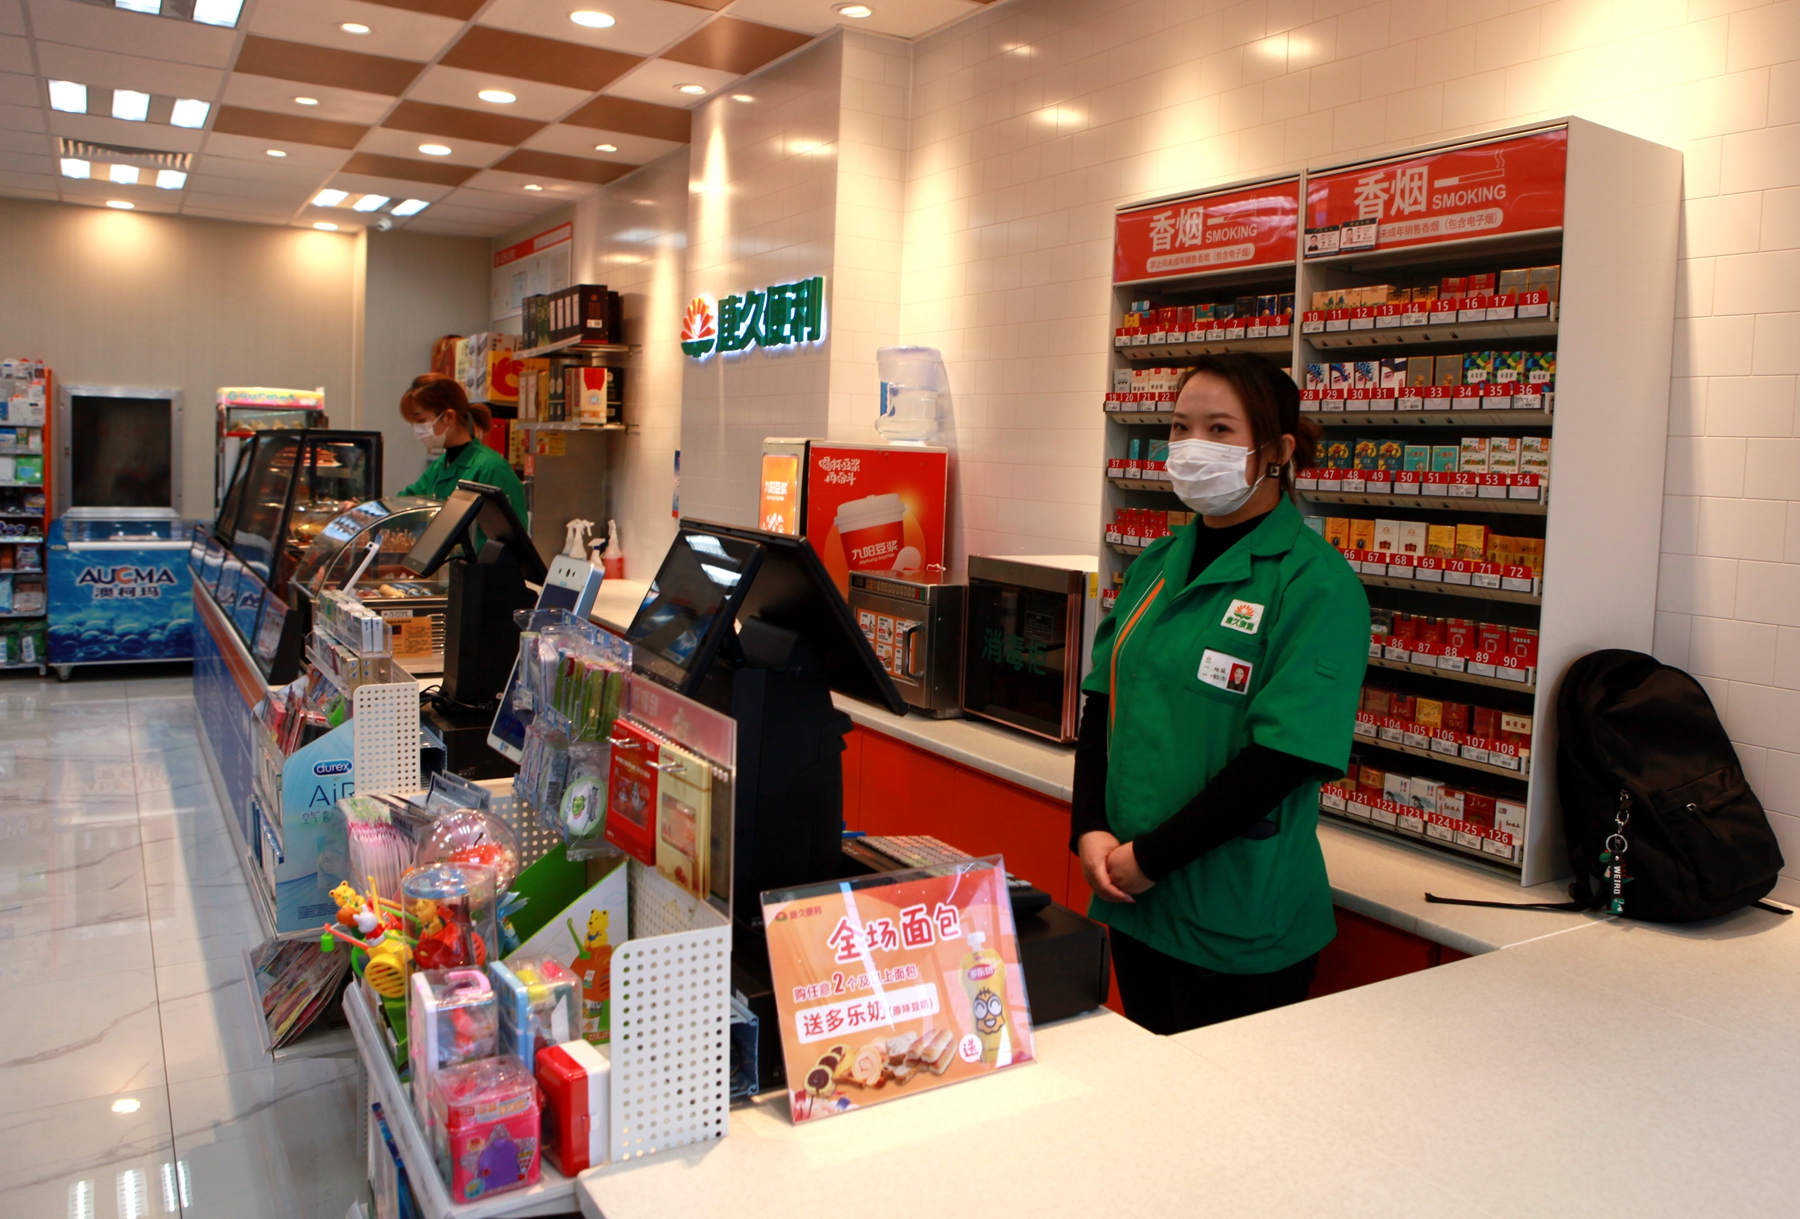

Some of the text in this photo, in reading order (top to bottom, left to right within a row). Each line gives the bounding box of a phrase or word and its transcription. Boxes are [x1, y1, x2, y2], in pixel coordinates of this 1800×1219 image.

[1354, 165, 1429, 221] 香烟
[1432, 184, 1507, 210] SMOKING
[1149, 206, 1204, 252] 香烟
[1377, 212, 1498, 239] 未成年销售香烟（包含电子烟）
[1205, 223, 1257, 244] SMOKING
[1465, 298, 1478, 309] 16
[1494, 296, 1507, 307] 17
[1525, 293, 1540, 304] 18
[1382, 305, 1394, 315] 13
[1407, 303, 1419, 314] 14
[1436, 301, 1449, 312] 15
[716, 277, 823, 352] 唐久便利
[1307, 312, 1318, 322] 10
[1331, 310, 1342, 319] 11
[1356, 308, 1367, 318] 12
[1303, 390, 1314, 400] 28
[1326, 390, 1337, 400] 29
[1352, 389, 1364, 399] 30
[1376, 389, 1387, 398] 31
[1404, 388, 1416, 397] 32
[1430, 387, 1442, 397] 33
[1459, 387, 1472, 397] 34
[1489, 385, 1503, 396] 35
[1519, 384, 1533, 395] 36
[227, 391, 297, 403] Gourmet
[1109, 393, 1117, 401] 19
[1125, 393, 1134, 401] 20
[1142, 393, 1150, 401] 21
[819, 456, 860, 472] 喝杯豆浆
[1146, 462, 1155, 470] 39
[824, 472, 856, 485] 再奋斗
[1323, 469, 1334, 479] 47
[1347, 471, 1358, 480] 48
[1372, 471, 1384, 481] 49
[1401, 472, 1413, 482] 50
[1428, 473, 1440, 483] 51
[1455, 474, 1468, 484] 52
[1485, 474, 1499, 485] 53
[1517, 475, 1531, 485] 54
[1109, 525, 1118, 533] 55
[1127, 527, 1135, 535] 56
[851, 540, 898, 560] 九阳豆浆
[1344, 550, 1355, 559] 66
[1367, 552, 1379, 562] 67
[1394, 555, 1407, 565] 68
[1422, 558, 1435, 568] 69
[1451, 560, 1464, 571] 70
[1479, 563, 1492, 574] 71
[78, 566, 176, 585] AUCMA
[1510, 567, 1524, 577] 72
[95, 587, 159, 598] 澳柯玛
[1107, 590, 1115, 598] 73
[1391, 638, 1404, 649] 86
[1418, 643, 1431, 653] 87
[982, 627, 1047, 676] 消毒柜
[1444, 646, 1458, 657] 88
[1475, 652, 1489, 663] 89
[1503, 656, 1517, 667] 90
[1357, 712, 1374, 723] 103
[1383, 718, 1401, 729] 104
[1408, 724, 1426, 736] 105
[1435, 729, 1455, 742] 106
[1466, 736, 1485, 748] 107
[1495, 742, 1515, 755] 108
[316, 762, 350, 774] durex
[1326, 786, 1343, 798] 120
[1352, 792, 1368, 804] 121
[1376, 799, 1394, 812] 122
[1402, 806, 1420, 819] 123
[1431, 814, 1450, 828] 124
[1458, 822, 1478, 835] 125
[1488, 829, 1508, 843] 126
[1613, 866, 1621, 894] WEIRD
[829, 904, 961, 961] 全场面包
[803, 1000, 885, 1036] 送多乐奶
[963, 1038, 979, 1058] 送
